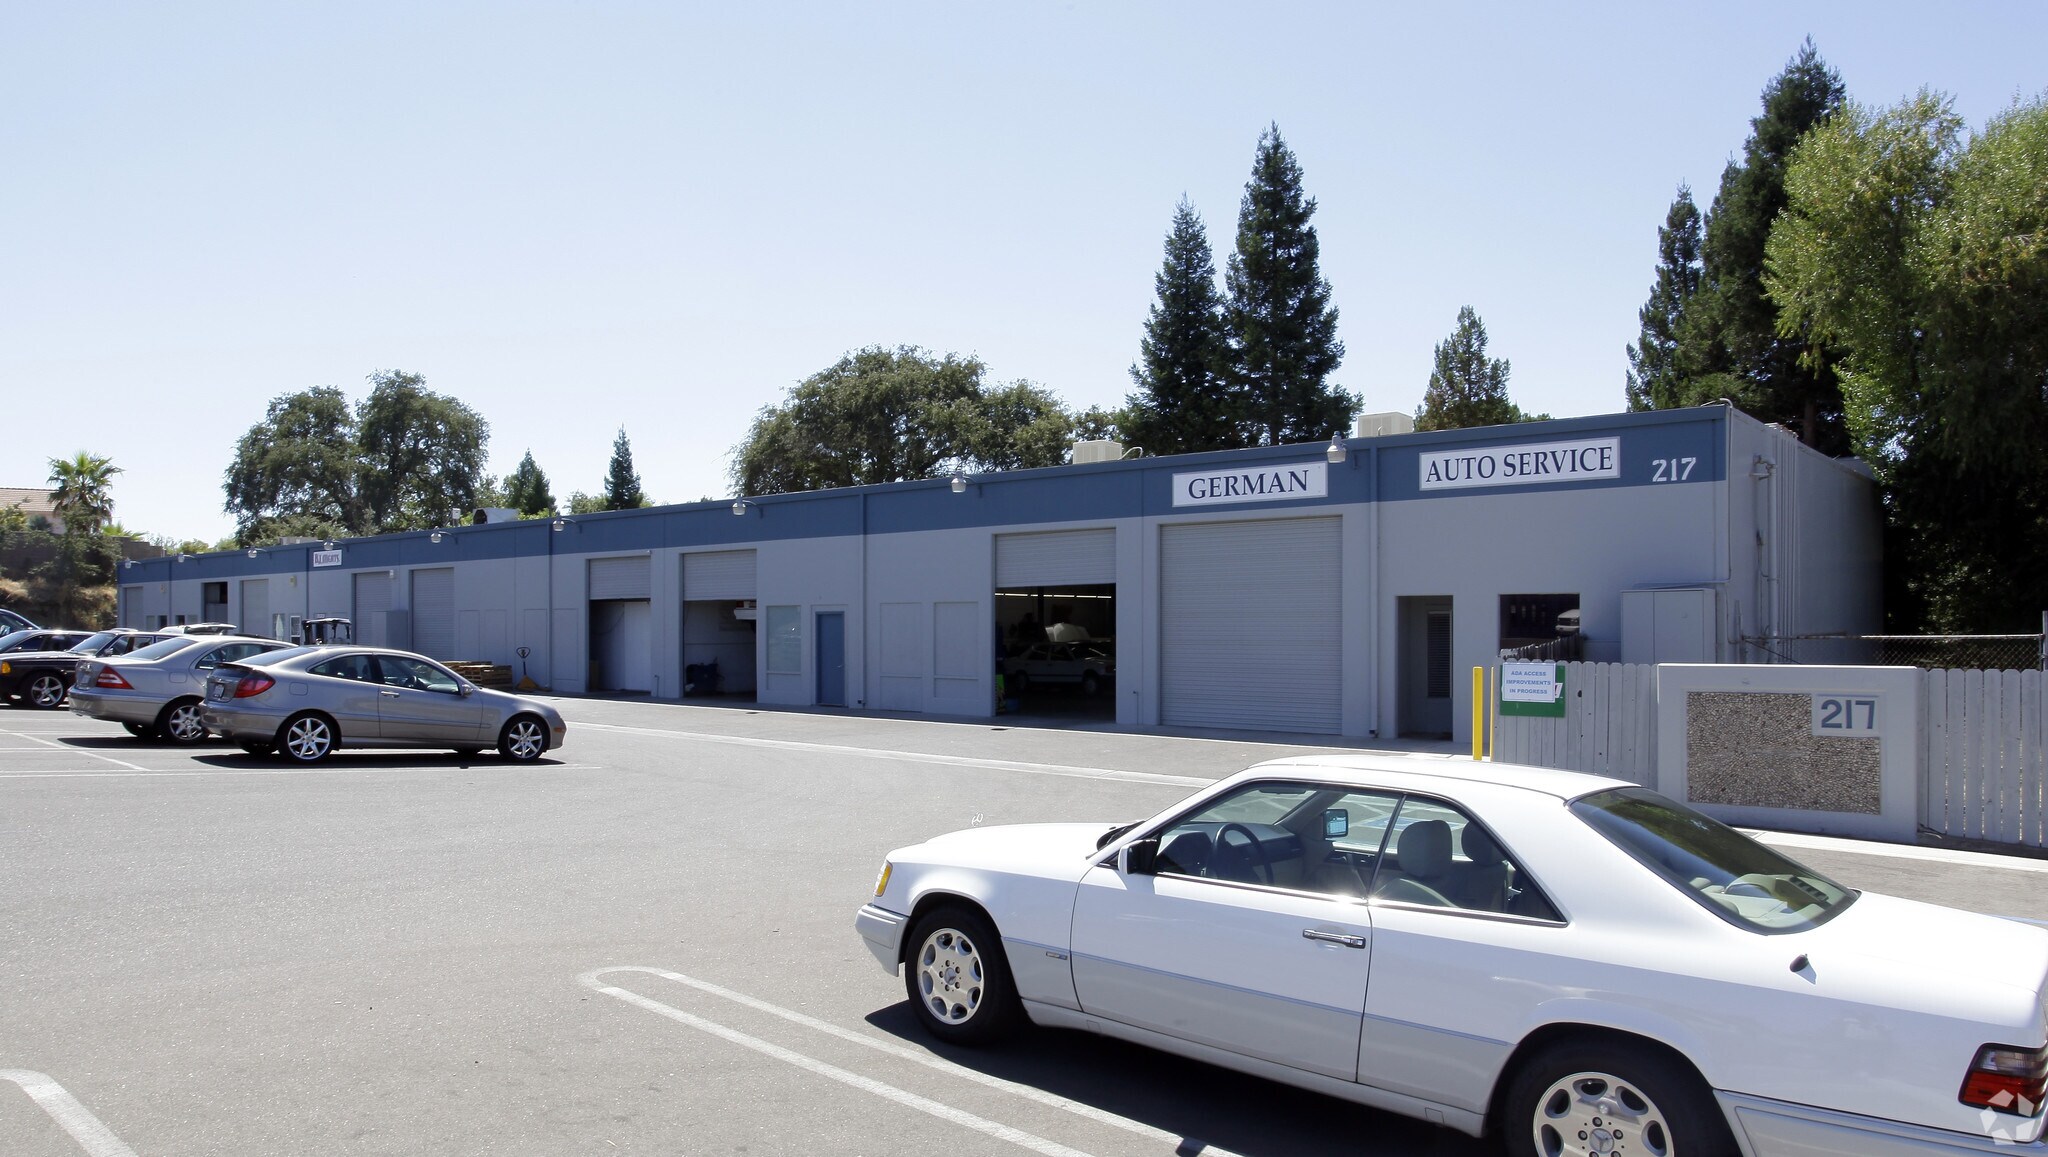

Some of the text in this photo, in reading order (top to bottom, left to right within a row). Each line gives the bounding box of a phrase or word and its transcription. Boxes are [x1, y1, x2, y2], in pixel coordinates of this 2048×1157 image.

[1425, 446, 1613, 483] AUTO SERVICE
[1652, 457, 1697, 482] 217
[1188, 469, 1309, 499] GERMAN
[1821, 699, 1875, 729] 217
